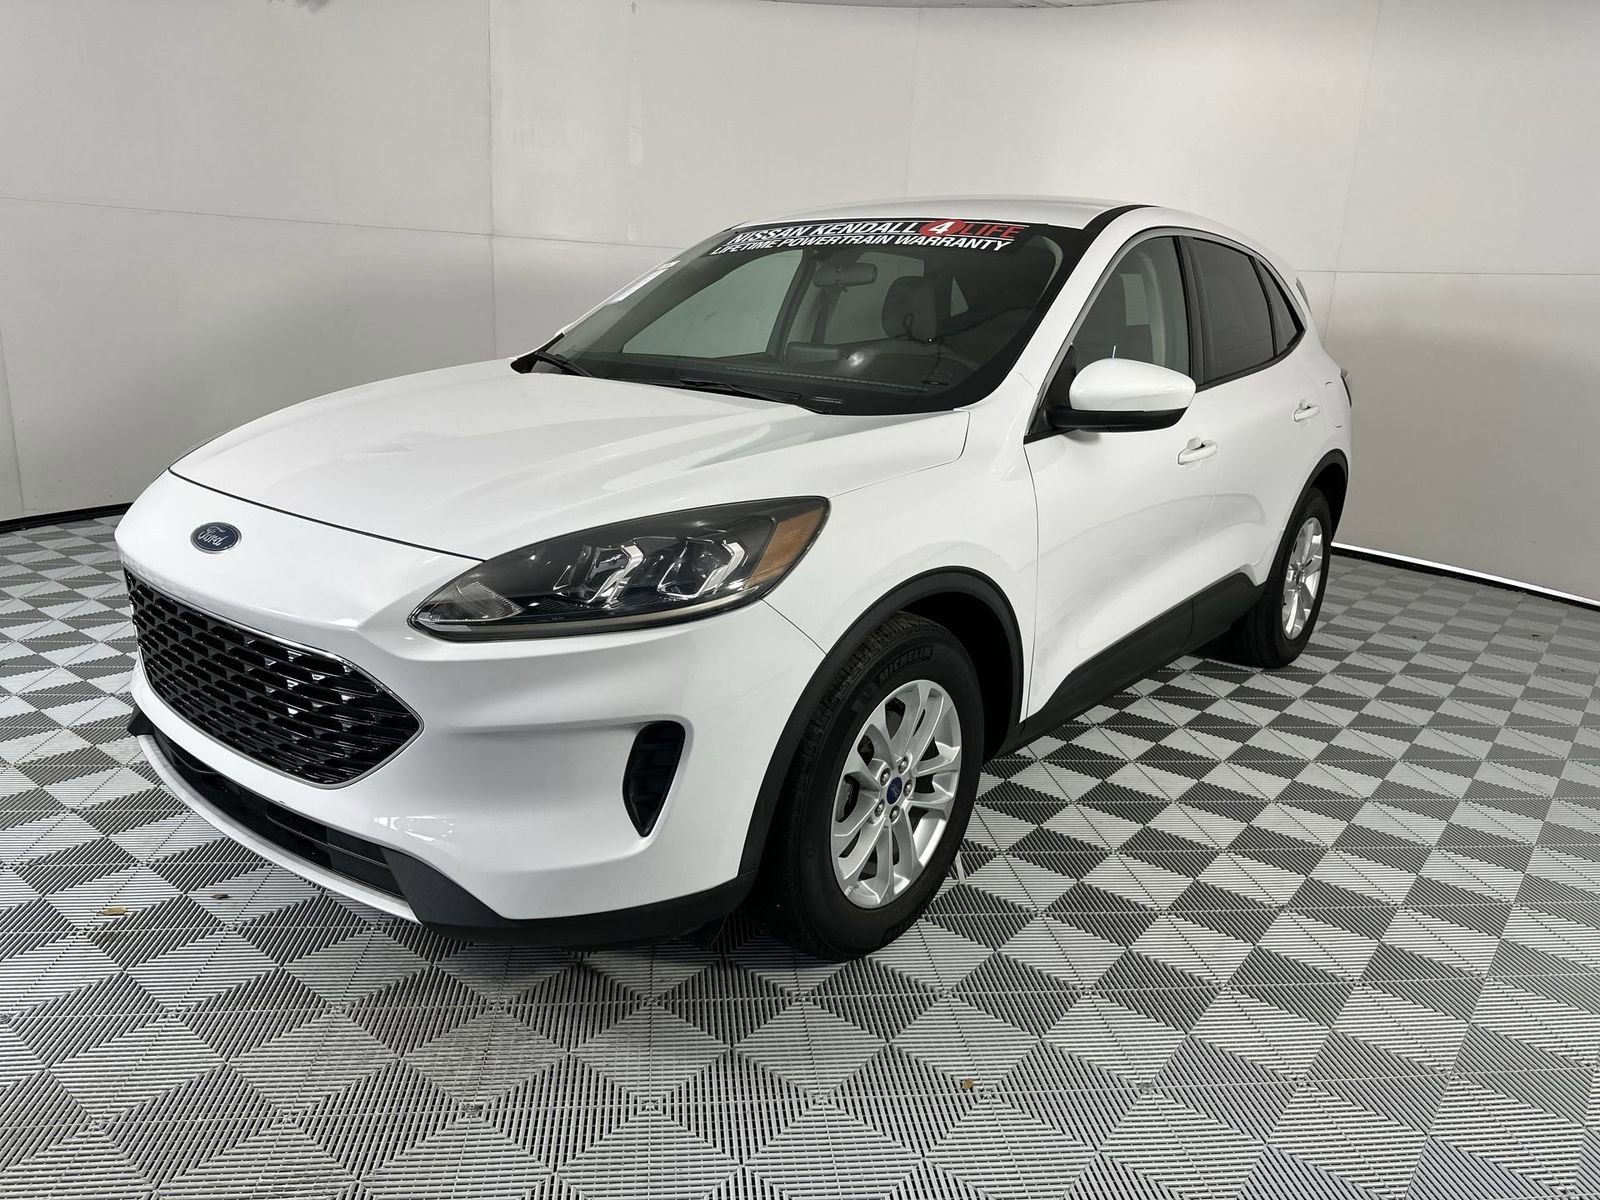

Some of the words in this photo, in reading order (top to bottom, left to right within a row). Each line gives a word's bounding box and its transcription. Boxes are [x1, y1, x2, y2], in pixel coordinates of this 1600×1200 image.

[727, 225, 813, 245] NISSAN
[811, 221, 919, 238] KENDALL
[928, 221, 955, 235] 4
[959, 224, 1025, 239] LIFE
[709, 239, 778, 256] LIFETIME
[776, 234, 895, 248] POWERTRAIN
[894, 235, 1012, 252] WARRANTY
[198, 525, 229, 547] Ford
[880, 646, 932, 681] MICHELIN
